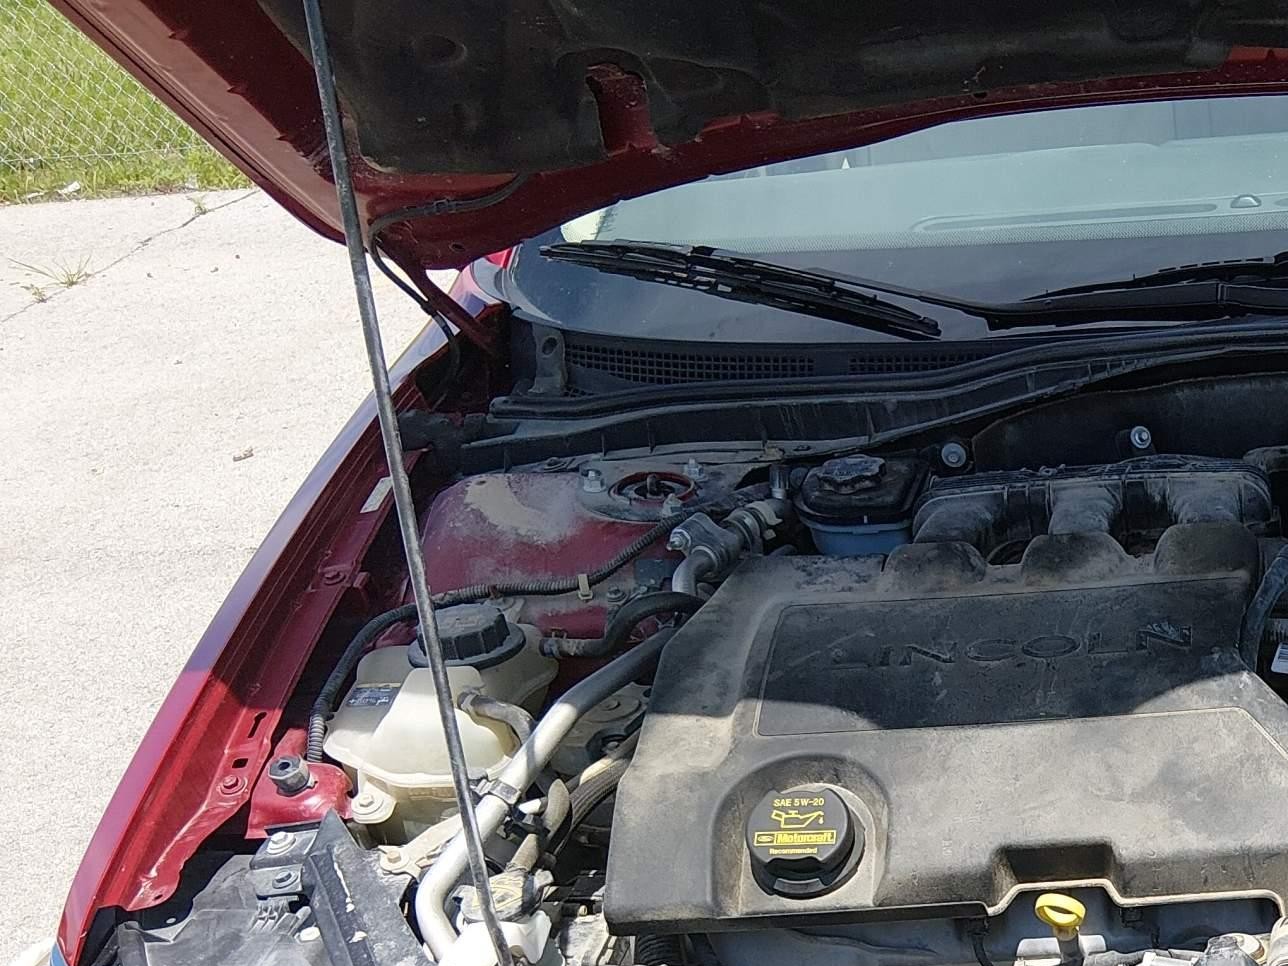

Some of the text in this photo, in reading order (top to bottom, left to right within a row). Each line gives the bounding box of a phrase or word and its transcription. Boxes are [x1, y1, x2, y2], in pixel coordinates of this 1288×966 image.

[829, 623, 1194, 670] LINCOLN
[773, 797, 825, 807] SAE 5W-20
[776, 832, 833, 844] Motorcraft
[769, 847, 818, 855] Recommended
